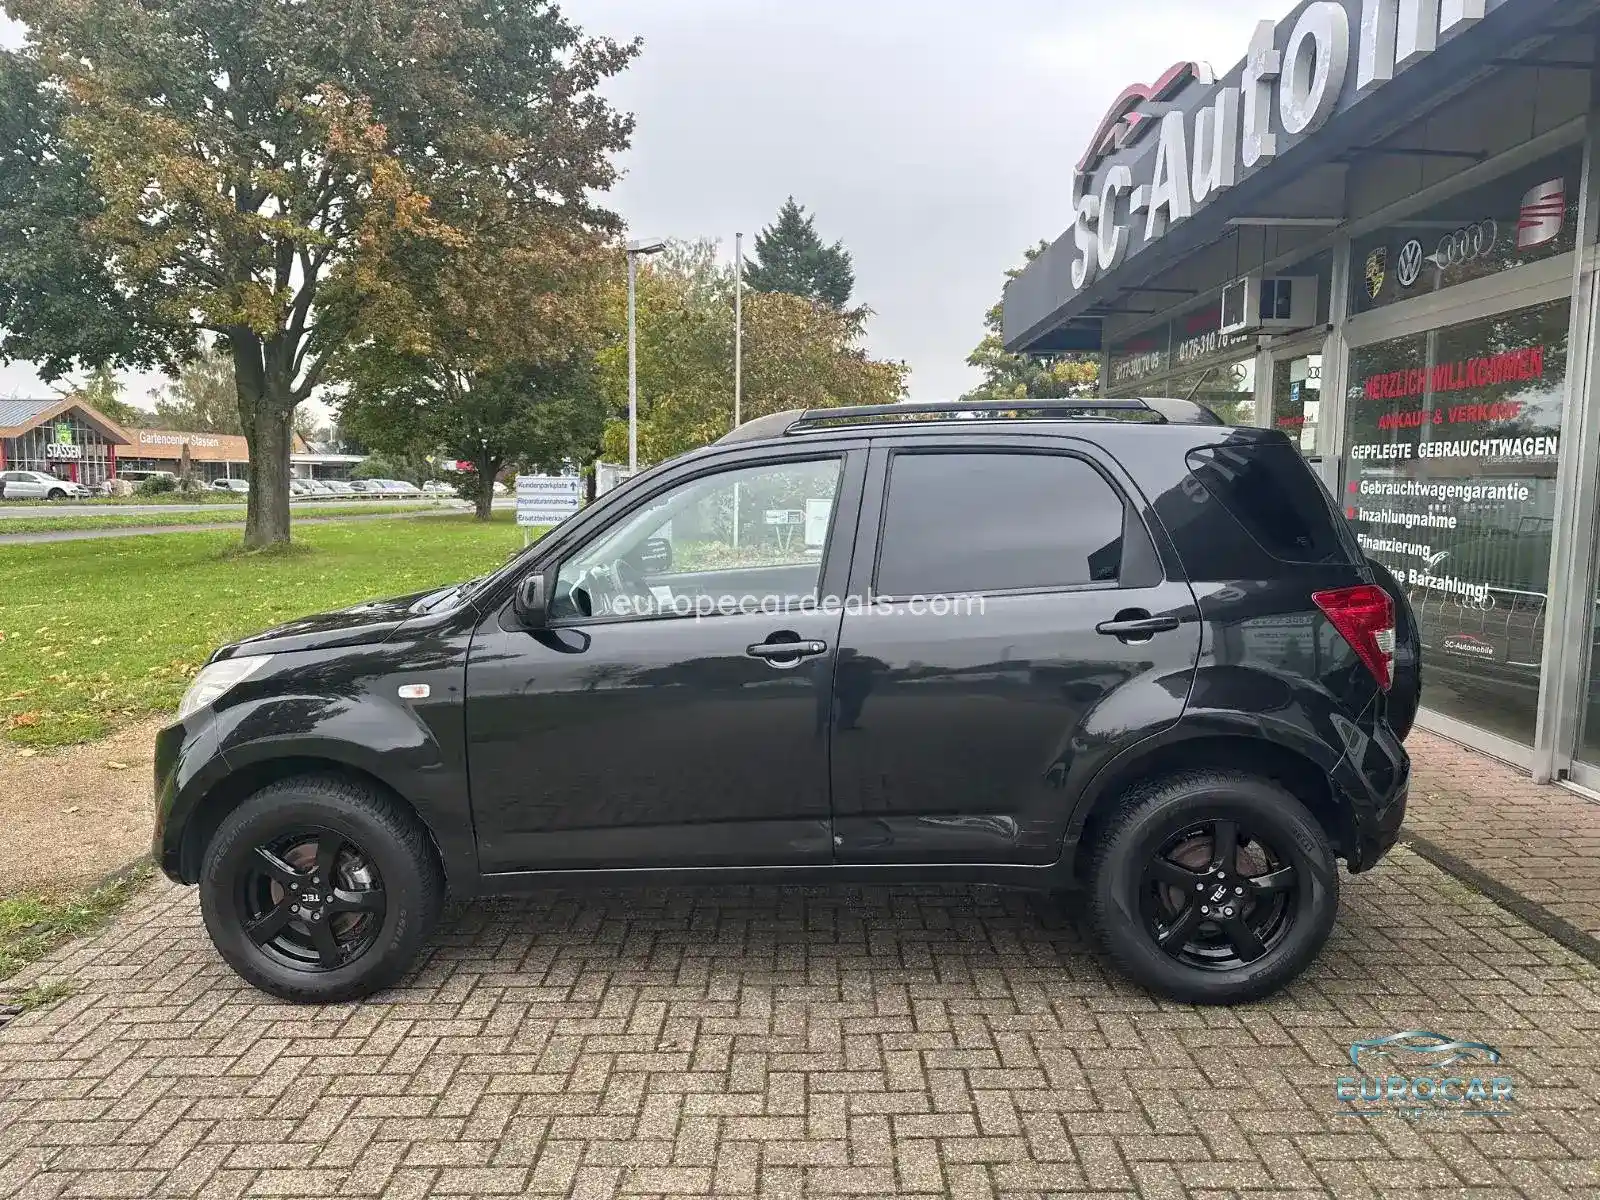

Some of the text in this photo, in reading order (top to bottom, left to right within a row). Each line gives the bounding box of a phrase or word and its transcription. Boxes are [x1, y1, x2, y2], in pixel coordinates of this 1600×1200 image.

[1429, 345, 1544, 392] WILLKOMMEN
[1433, 408, 1443, 425] &
[139, 431, 219, 447] Gartencenter Stassen
[1351, 436, 1557, 460] GEPFLEGTE GEBRAUCHTWAGEN
[47, 443, 82, 459] STASSEN
[518, 481, 567, 490] Kundenparkplatz
[1360, 479, 1529, 502] Gebrauchtwagengarantie
[1358, 507, 1457, 529] Inzahlungnahme
[1357, 533, 1431, 561] Finanzierung
[1408, 568, 1489, 601] Barzahlung!
[1444, 639, 1493, 655] SC-Automobile
[302, 893, 320, 902] TEC
[1210, 885, 1227, 903] TEC
